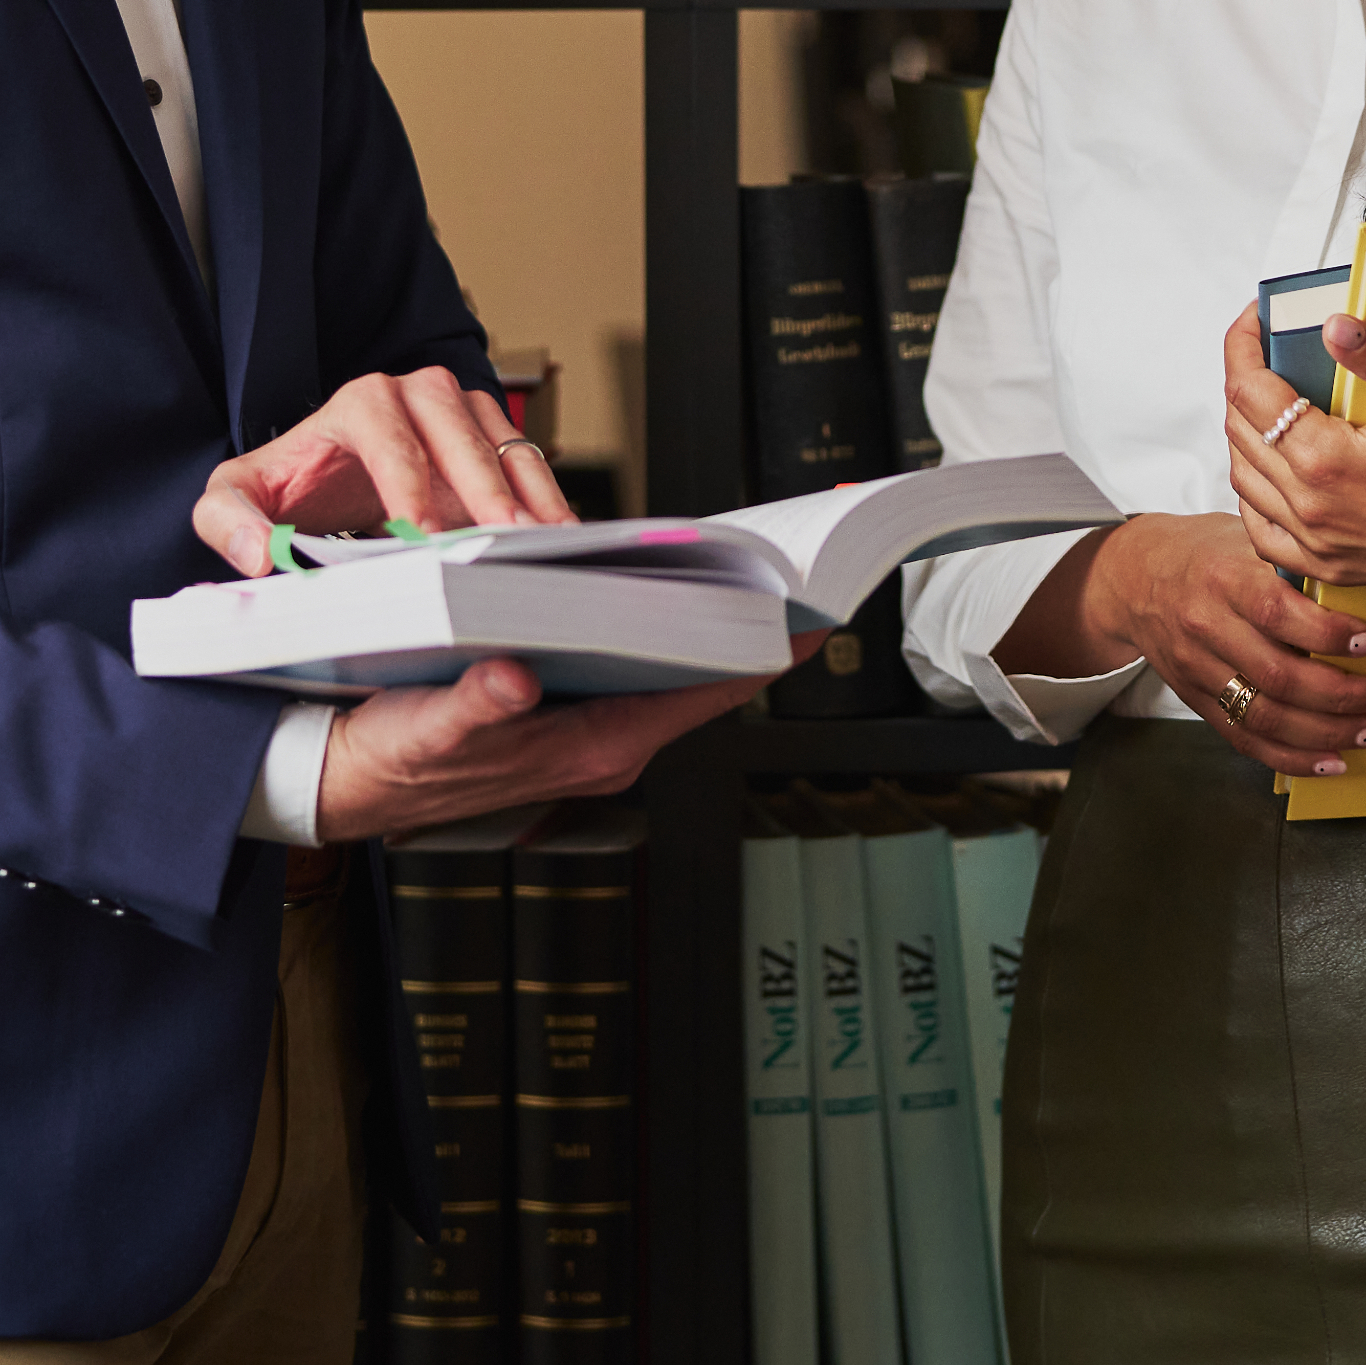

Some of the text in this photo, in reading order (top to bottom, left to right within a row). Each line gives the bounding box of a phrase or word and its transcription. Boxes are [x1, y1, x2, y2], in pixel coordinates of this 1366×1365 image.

[760, 939, 801, 1072] NotBZ
[822, 938, 868, 1072] NotBZ
[896, 934, 944, 1067] NotBZ
